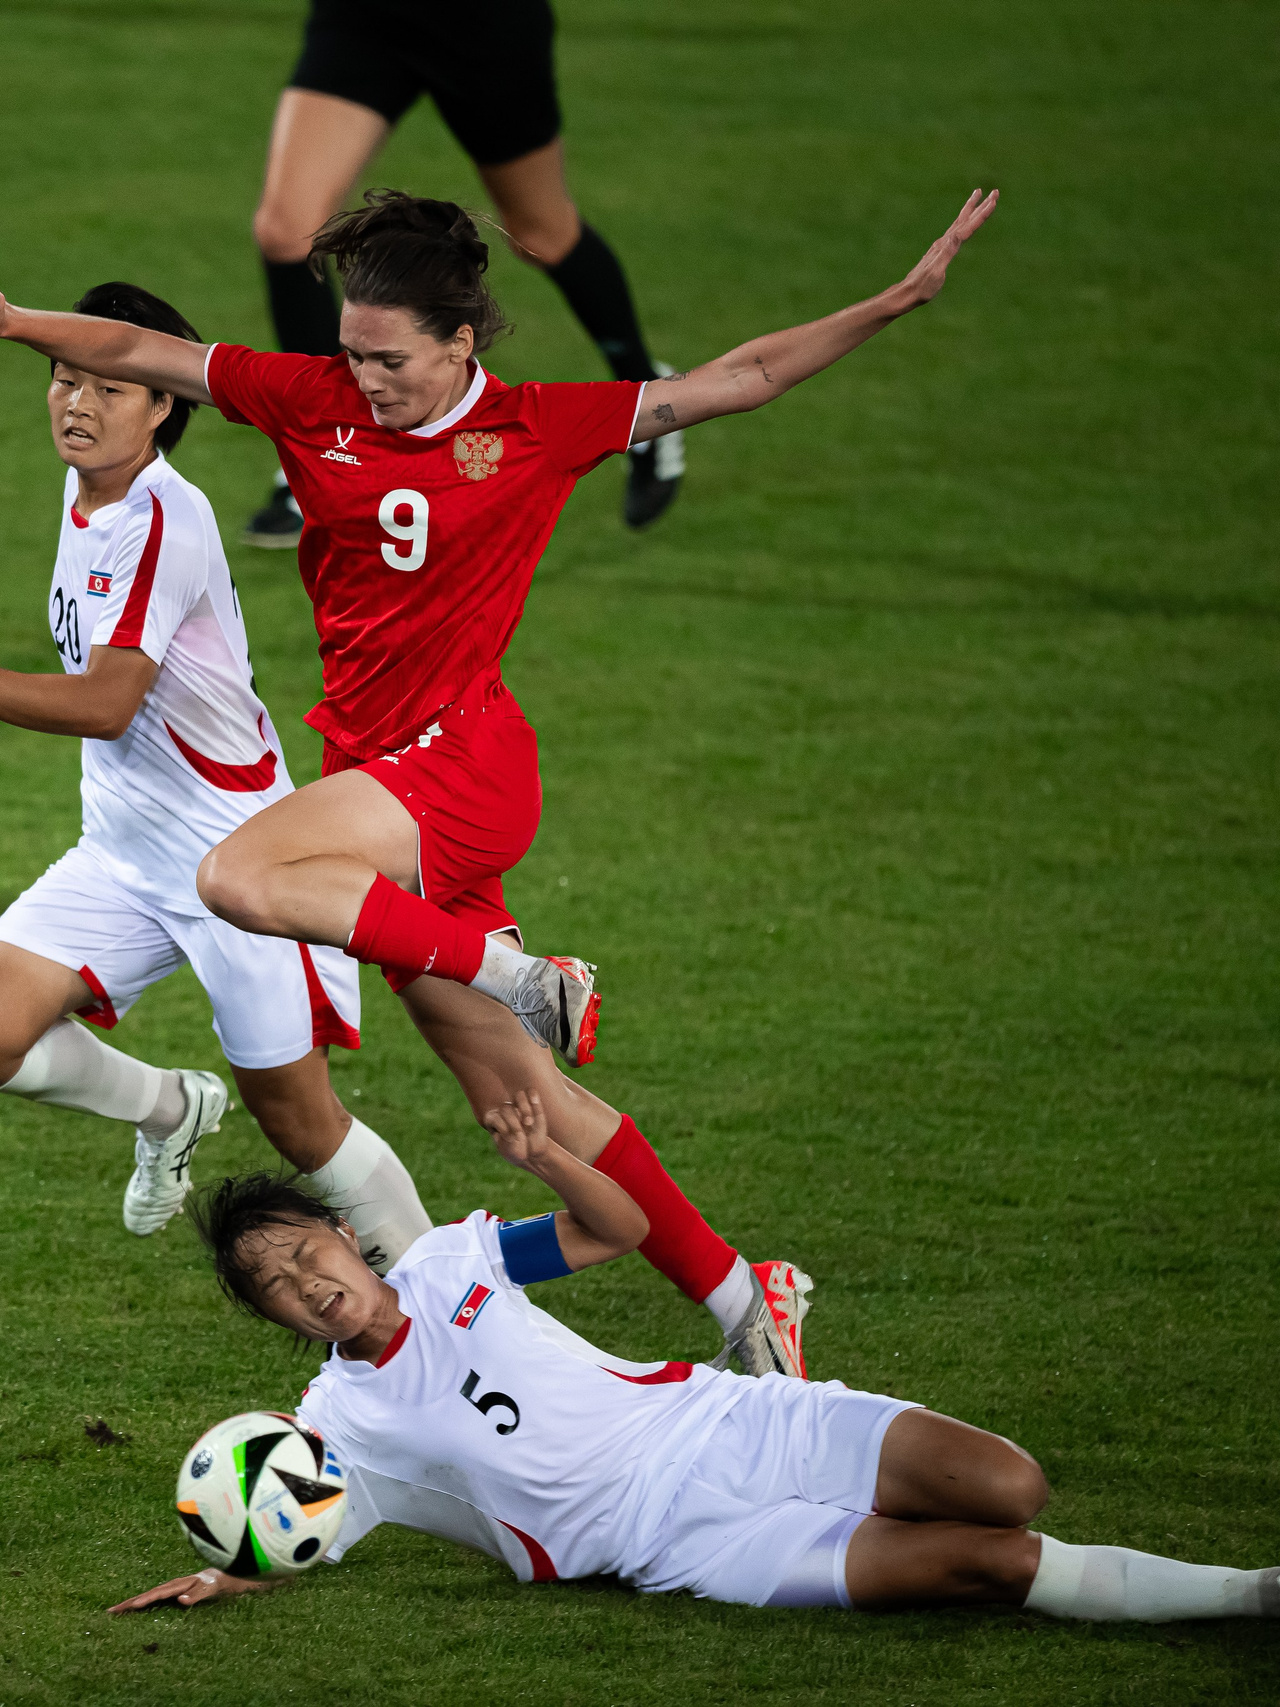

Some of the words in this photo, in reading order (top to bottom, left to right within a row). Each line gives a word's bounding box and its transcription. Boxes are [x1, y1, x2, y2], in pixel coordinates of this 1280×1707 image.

[320, 449, 362, 466] JÖGEL
[378, 489, 429, 571] 9
[52, 587, 81, 665] 20
[460, 1369, 520, 1435] 5
